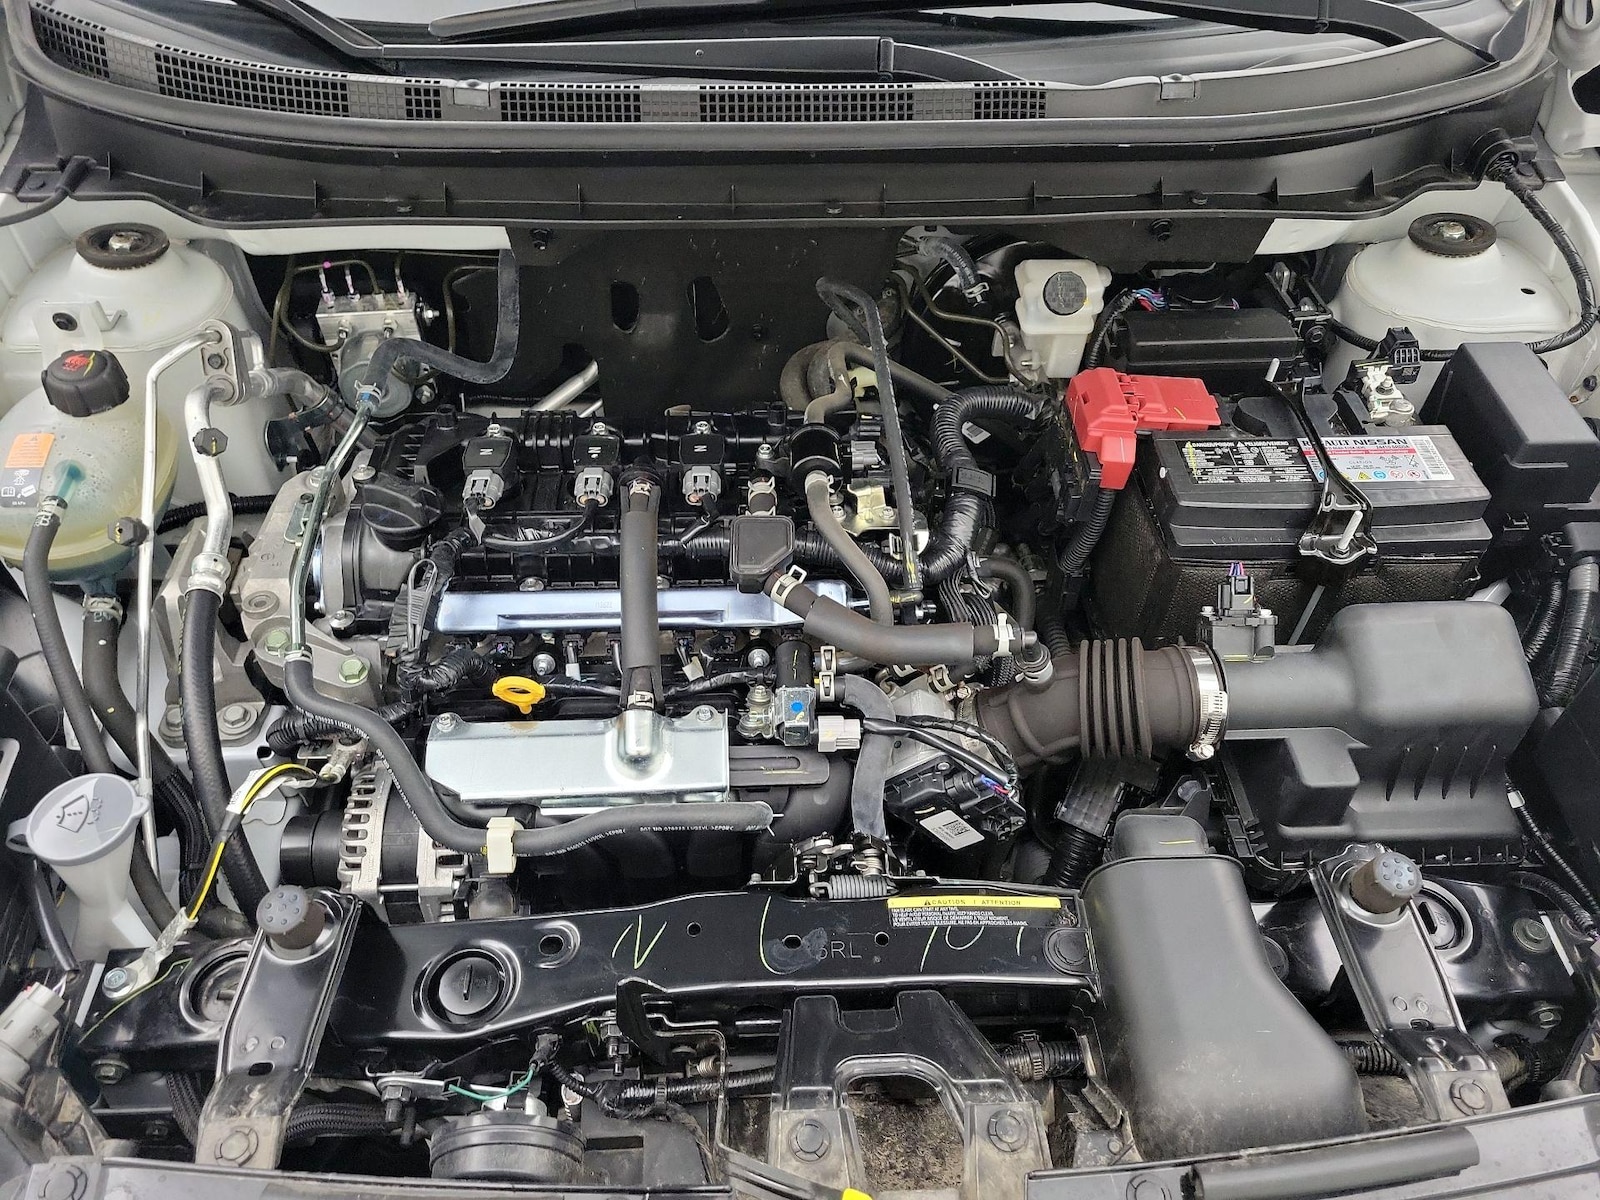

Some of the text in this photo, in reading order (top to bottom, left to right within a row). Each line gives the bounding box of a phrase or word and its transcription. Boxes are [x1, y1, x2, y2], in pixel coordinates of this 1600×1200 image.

[1301, 438, 1408, 447] RAULT NISSAN
[931, 898, 966, 906] CAUTION
